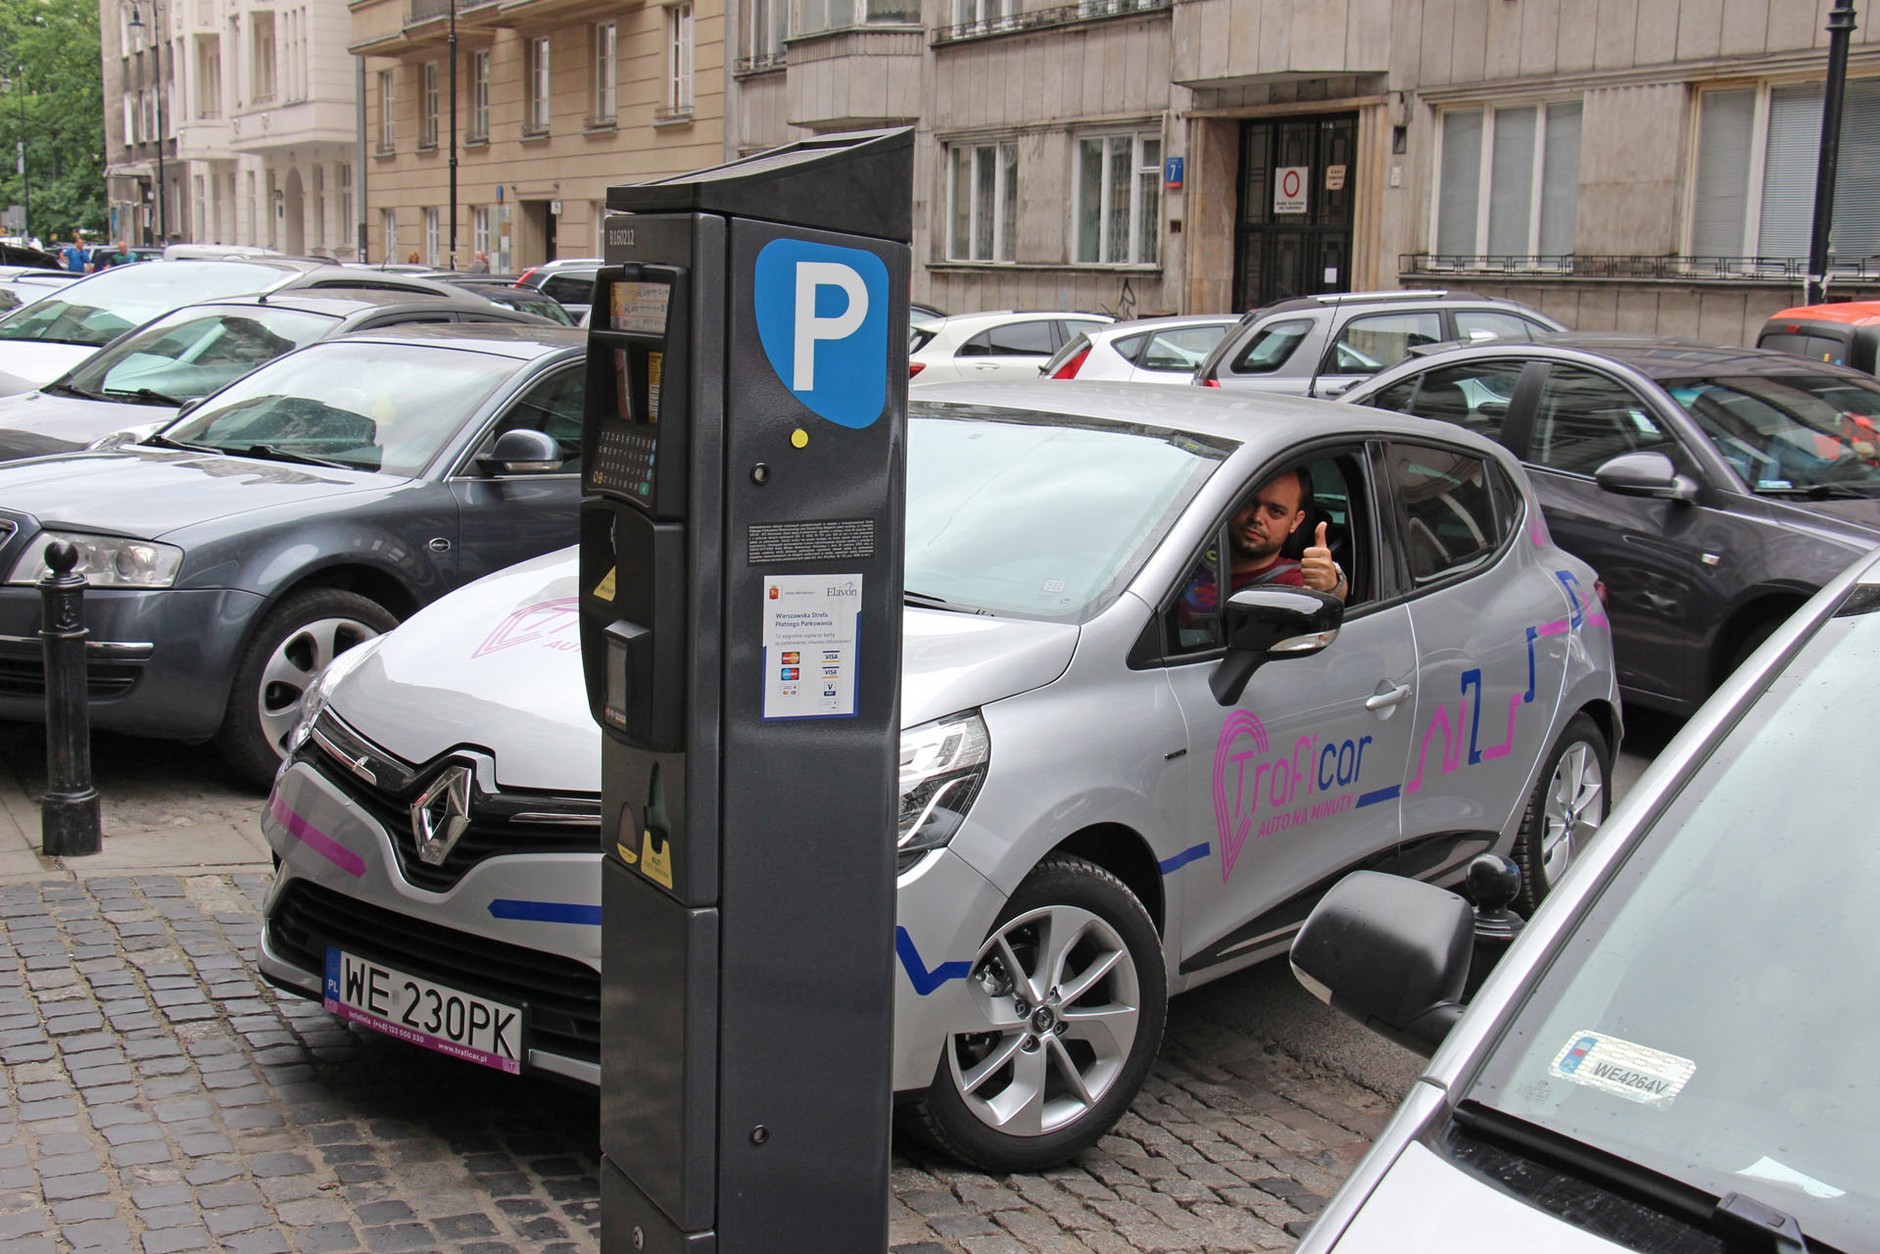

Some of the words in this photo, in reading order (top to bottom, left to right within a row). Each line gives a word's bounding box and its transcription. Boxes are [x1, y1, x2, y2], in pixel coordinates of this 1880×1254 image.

[1170, 164, 1176, 181] 7
[793, 261, 869, 391] P
[827, 586, 857, 597] Elavon
[1230, 731, 1373, 819] Traficar
[1258, 815, 1291, 838] AUTO
[1291, 811, 1308, 826] NA
[1311, 794, 1354, 820] MINUTY
[328, 979, 338, 993] PL
[346, 958, 389, 1017] WE
[402, 981, 516, 1060] 230PK
[438, 1042, 488, 1063] www.traficar.pl
[1594, 1062, 1669, 1094] WE4264V
